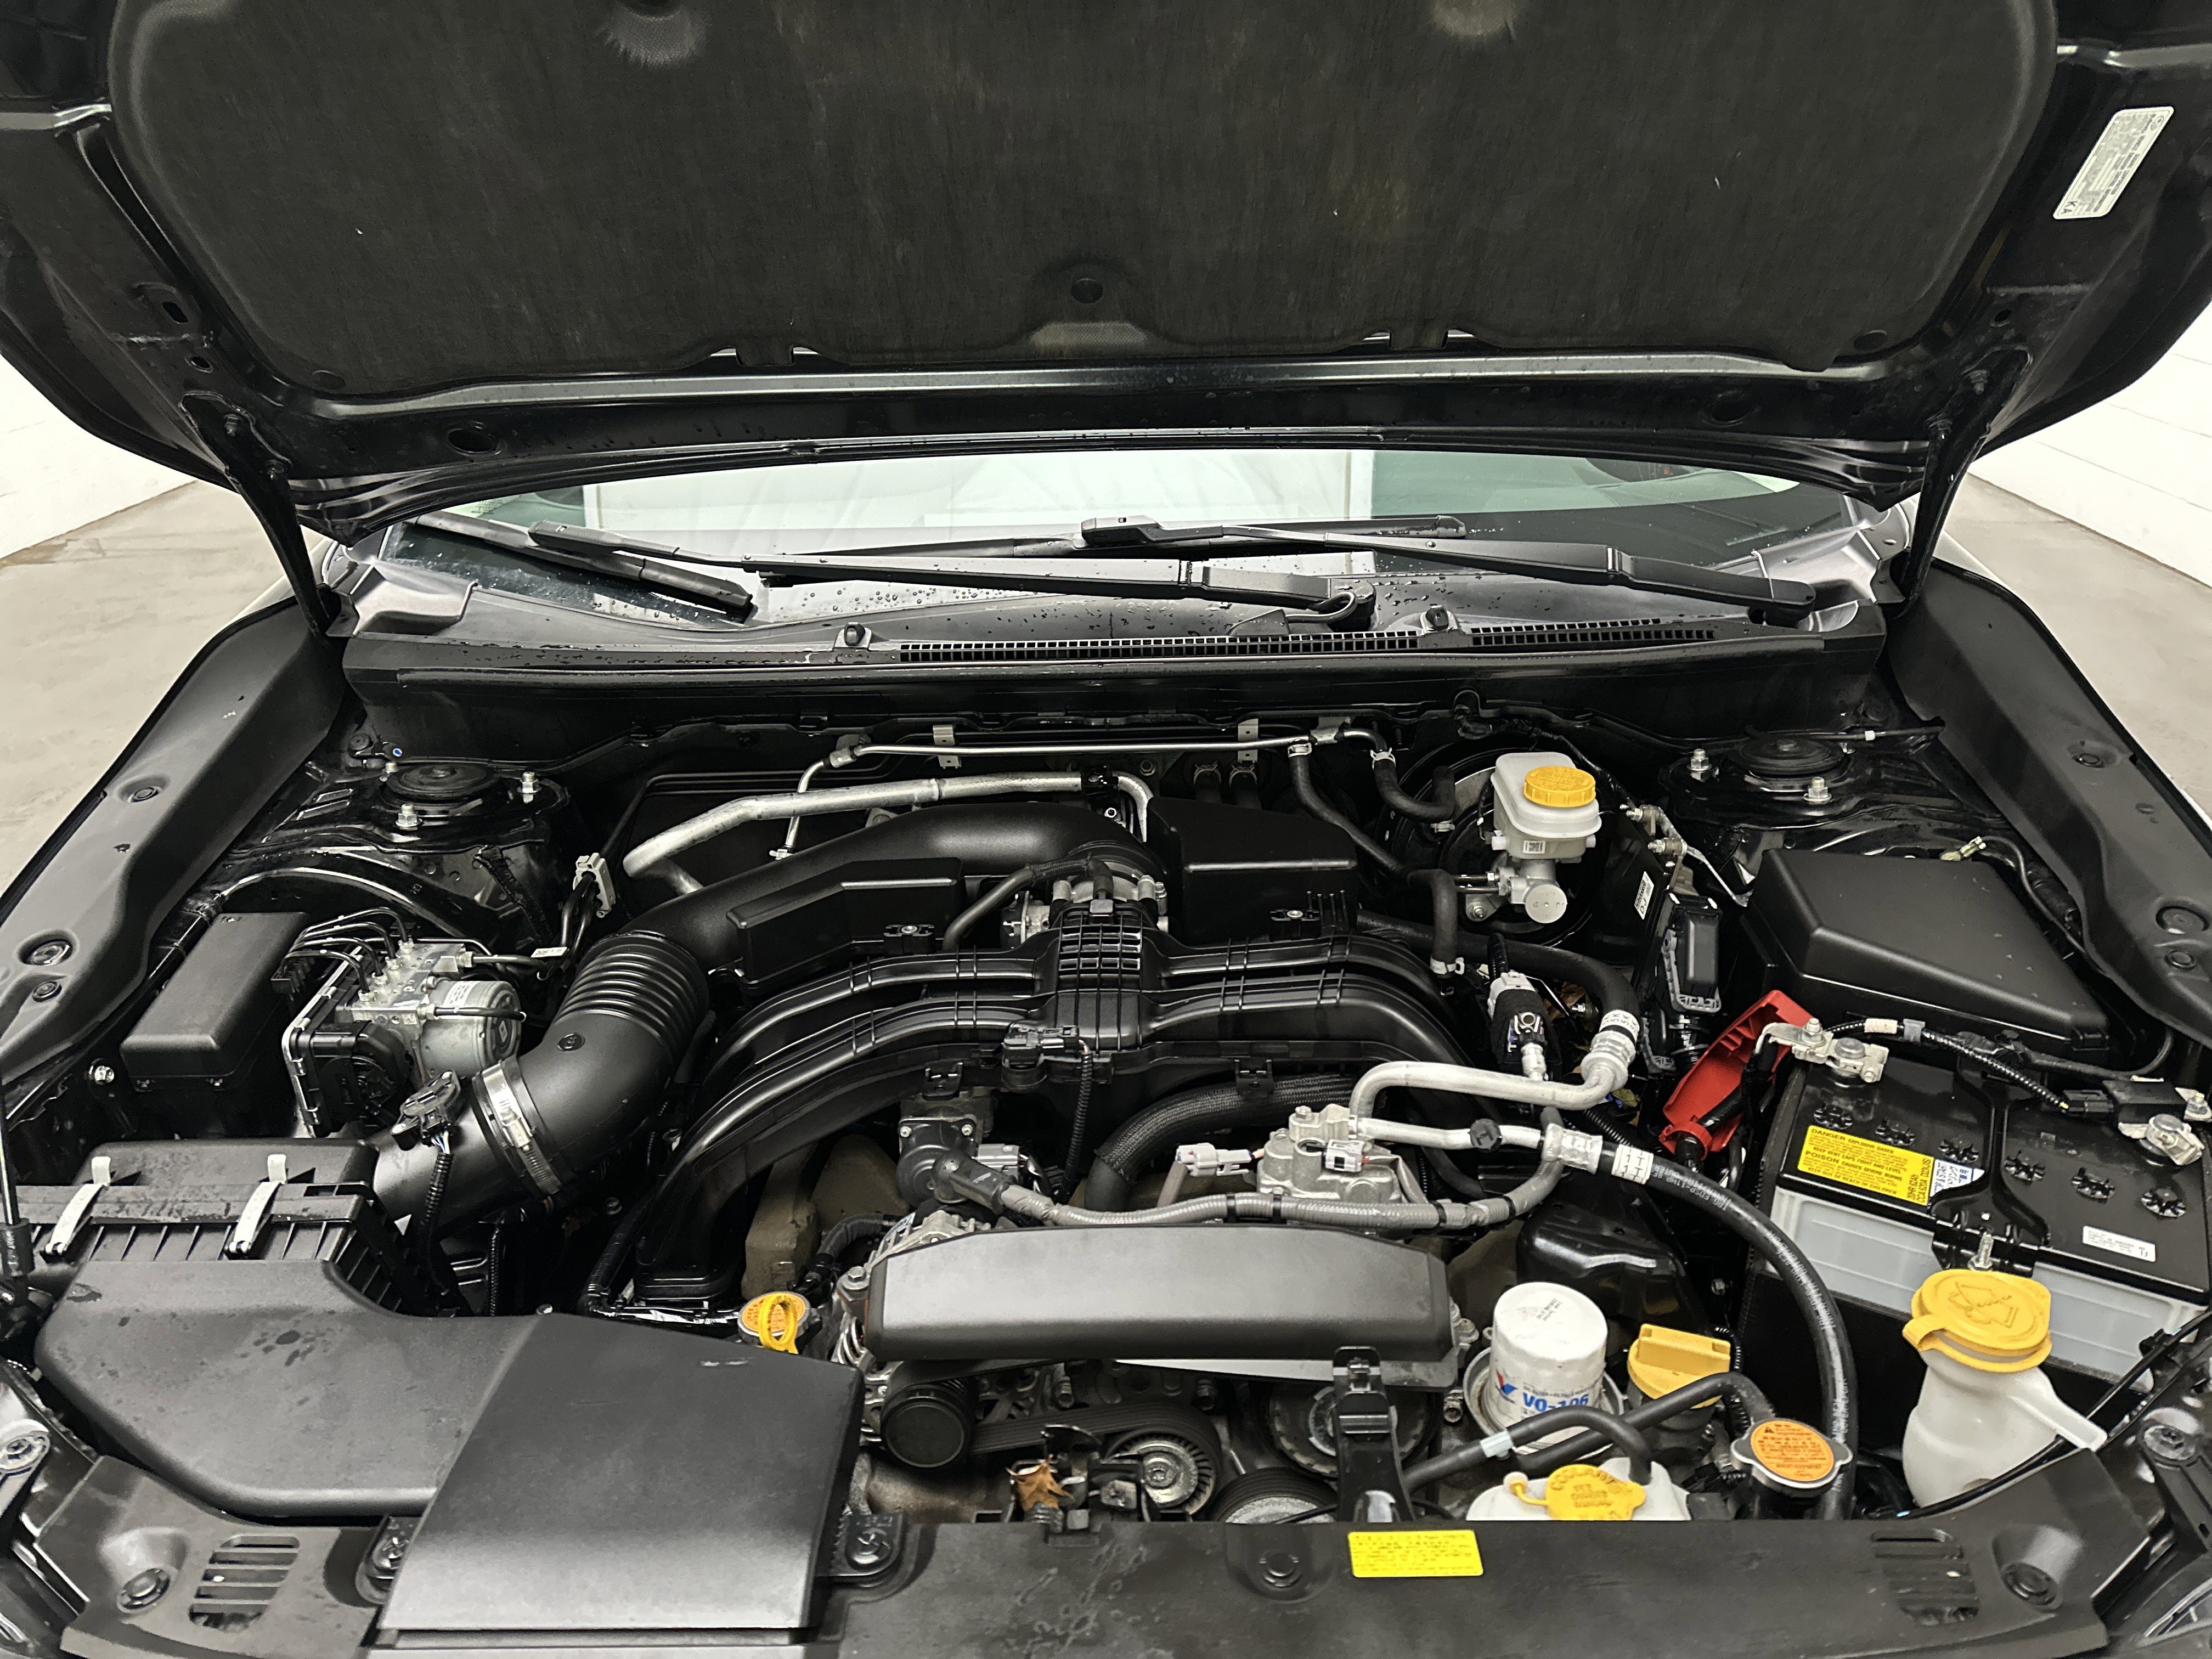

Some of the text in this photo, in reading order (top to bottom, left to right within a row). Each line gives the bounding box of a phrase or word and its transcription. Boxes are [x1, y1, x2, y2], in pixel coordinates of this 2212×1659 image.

[1810, 1128, 1846, 1141] DANGER
[1847, 1138, 1875, 1149] EXPLOSIVE
[1804, 1150, 1839, 1164] POISON
[1841, 1154, 1856, 1162] CAPS
